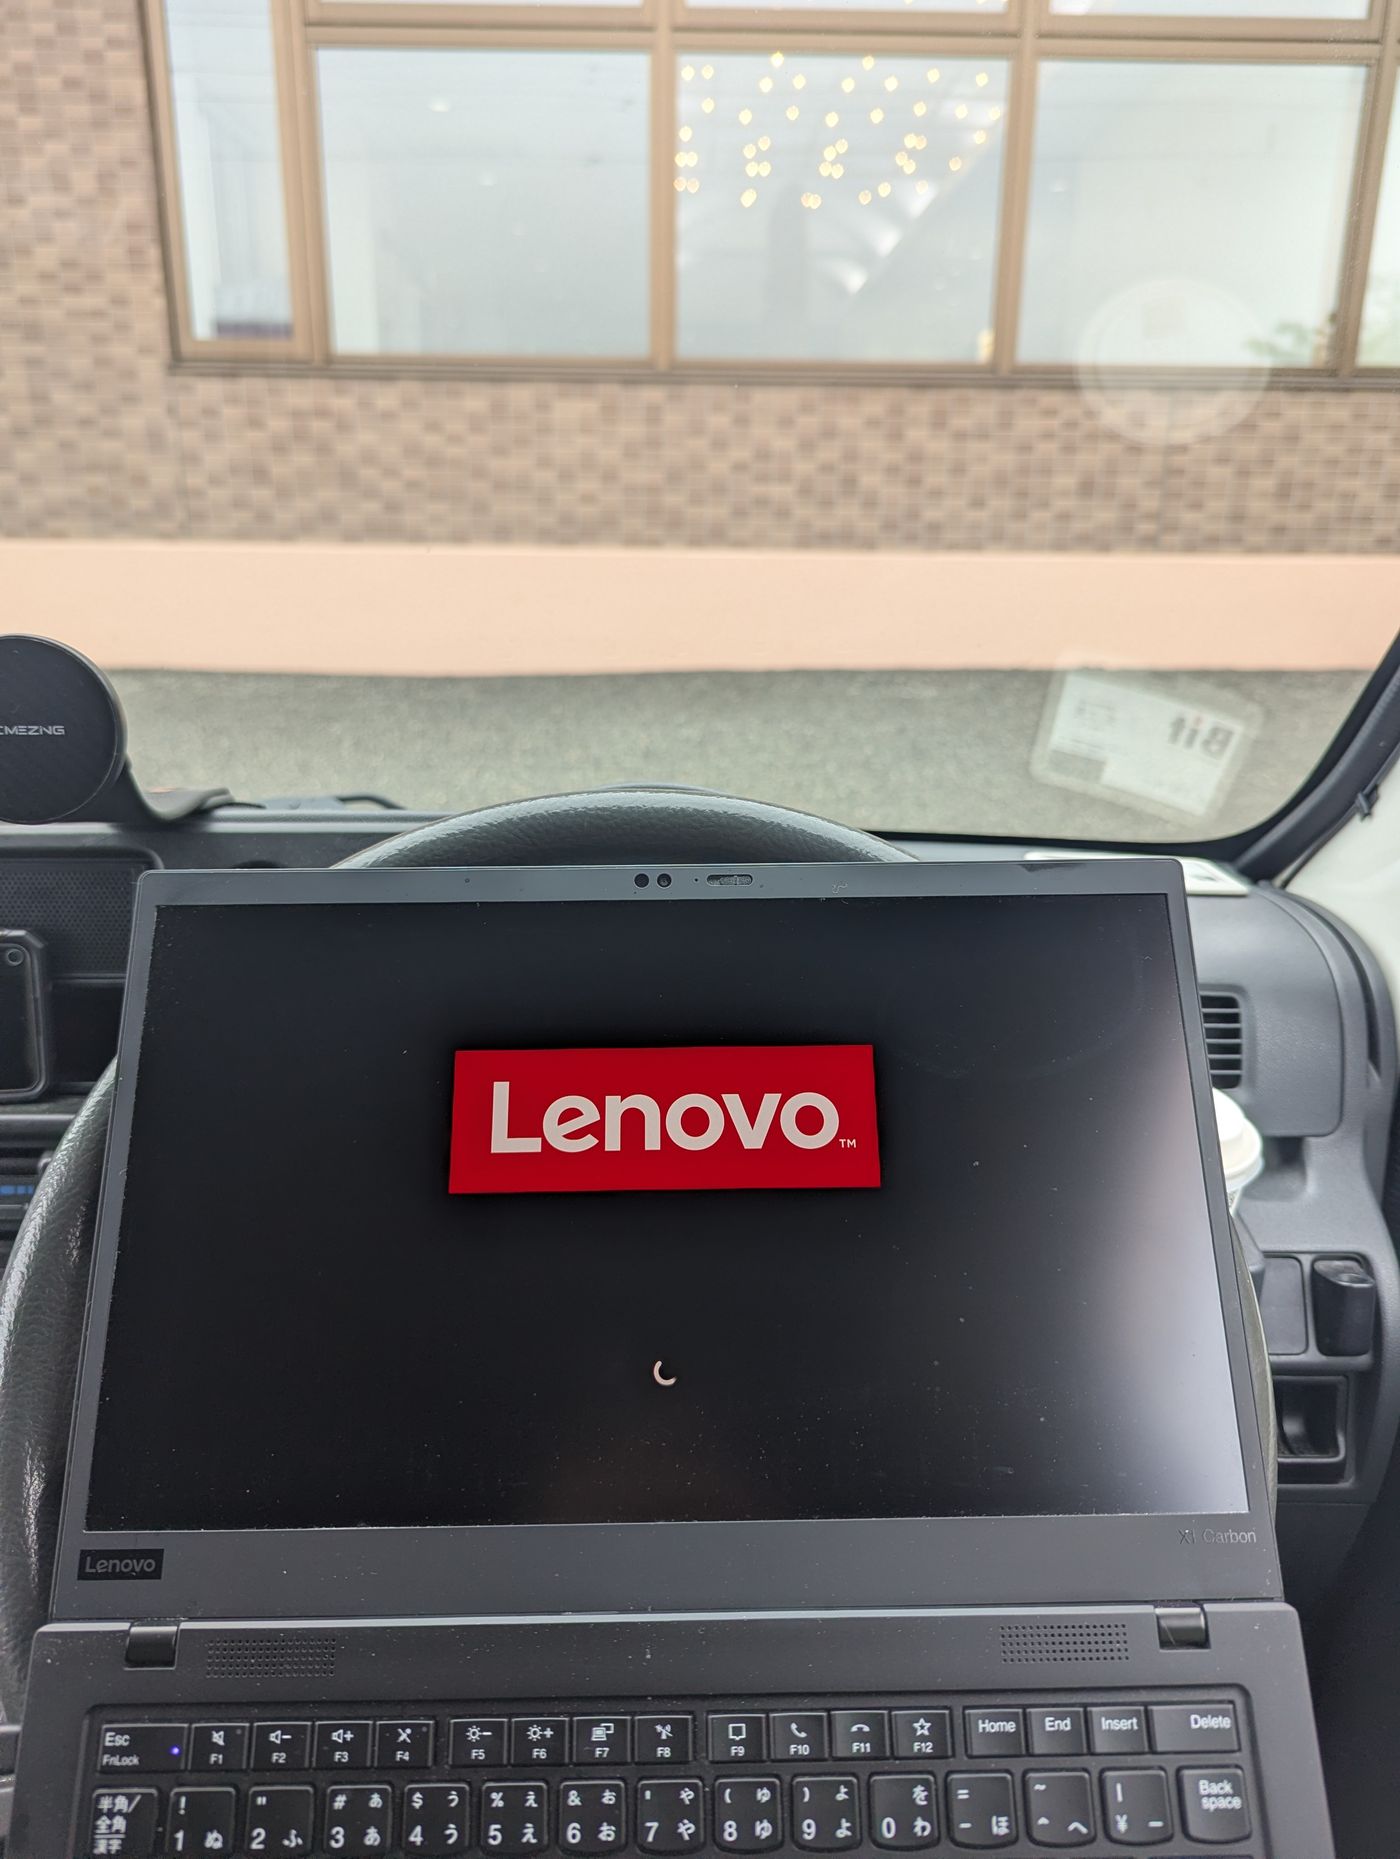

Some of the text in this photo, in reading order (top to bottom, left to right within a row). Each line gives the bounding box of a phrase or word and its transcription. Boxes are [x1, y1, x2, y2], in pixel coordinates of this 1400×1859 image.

[491, 1081, 840, 1153] Lenovo
[1203, 1528, 1257, 1544] Carbon
[85, 1556, 156, 1573] Lenovo
[978, 1720, 1016, 1732] Home
[1045, 1717, 1071, 1731] End
[1101, 1717, 1138, 1730] Insert
[1190, 1715, 1231, 1729] Delete
[104, 1731, 130, 1747] Esc
[471, 1748, 486, 1760] F5
[532, 1748, 547, 1759] F6
[594, 1747, 610, 1758] F7
[656, 1746, 672, 1758] F8
[730, 1745, 745, 1757] F9
[789, 1744, 810, 1756] F10
[851, 1742, 871, 1753] F11
[913, 1741, 933, 1753] F12
[102, 1754, 140, 1767] FnLock
[209, 1753, 223, 1765] F1
[271, 1752, 287, 1764] F2
[334, 1751, 349, 1763] F3
[395, 1750, 410, 1761] F4
[803, 1787, 809, 1802] )
[913, 1785, 928, 1805] を
[1198, 1780, 1233, 1795] Back
[334, 1795, 346, 1809] #
[412, 1792, 423, 1809] $
[491, 1792, 504, 1807] %
[568, 1790, 581, 1806] &
[725, 1789, 731, 1803] (
[179, 1796, 186, 1814] !
[1200, 1796, 1242, 1812] space
[95, 1815, 127, 1833] 全角
[724, 1821, 737, 1841] 8
[802, 1819, 816, 1840] 9
[882, 1817, 931, 1838] 0 わ
[1116, 1815, 1127, 1833] ¥
[251, 1828, 302, 1849] 2 ふ
[330, 1827, 344, 1848] 3
[409, 1825, 423, 1845] 4
[488, 1825, 502, 1845] 5
[567, 1823, 581, 1843] 6
[645, 1822, 659, 1842] 7
[175, 1830, 222, 1851] 1 ぬ
